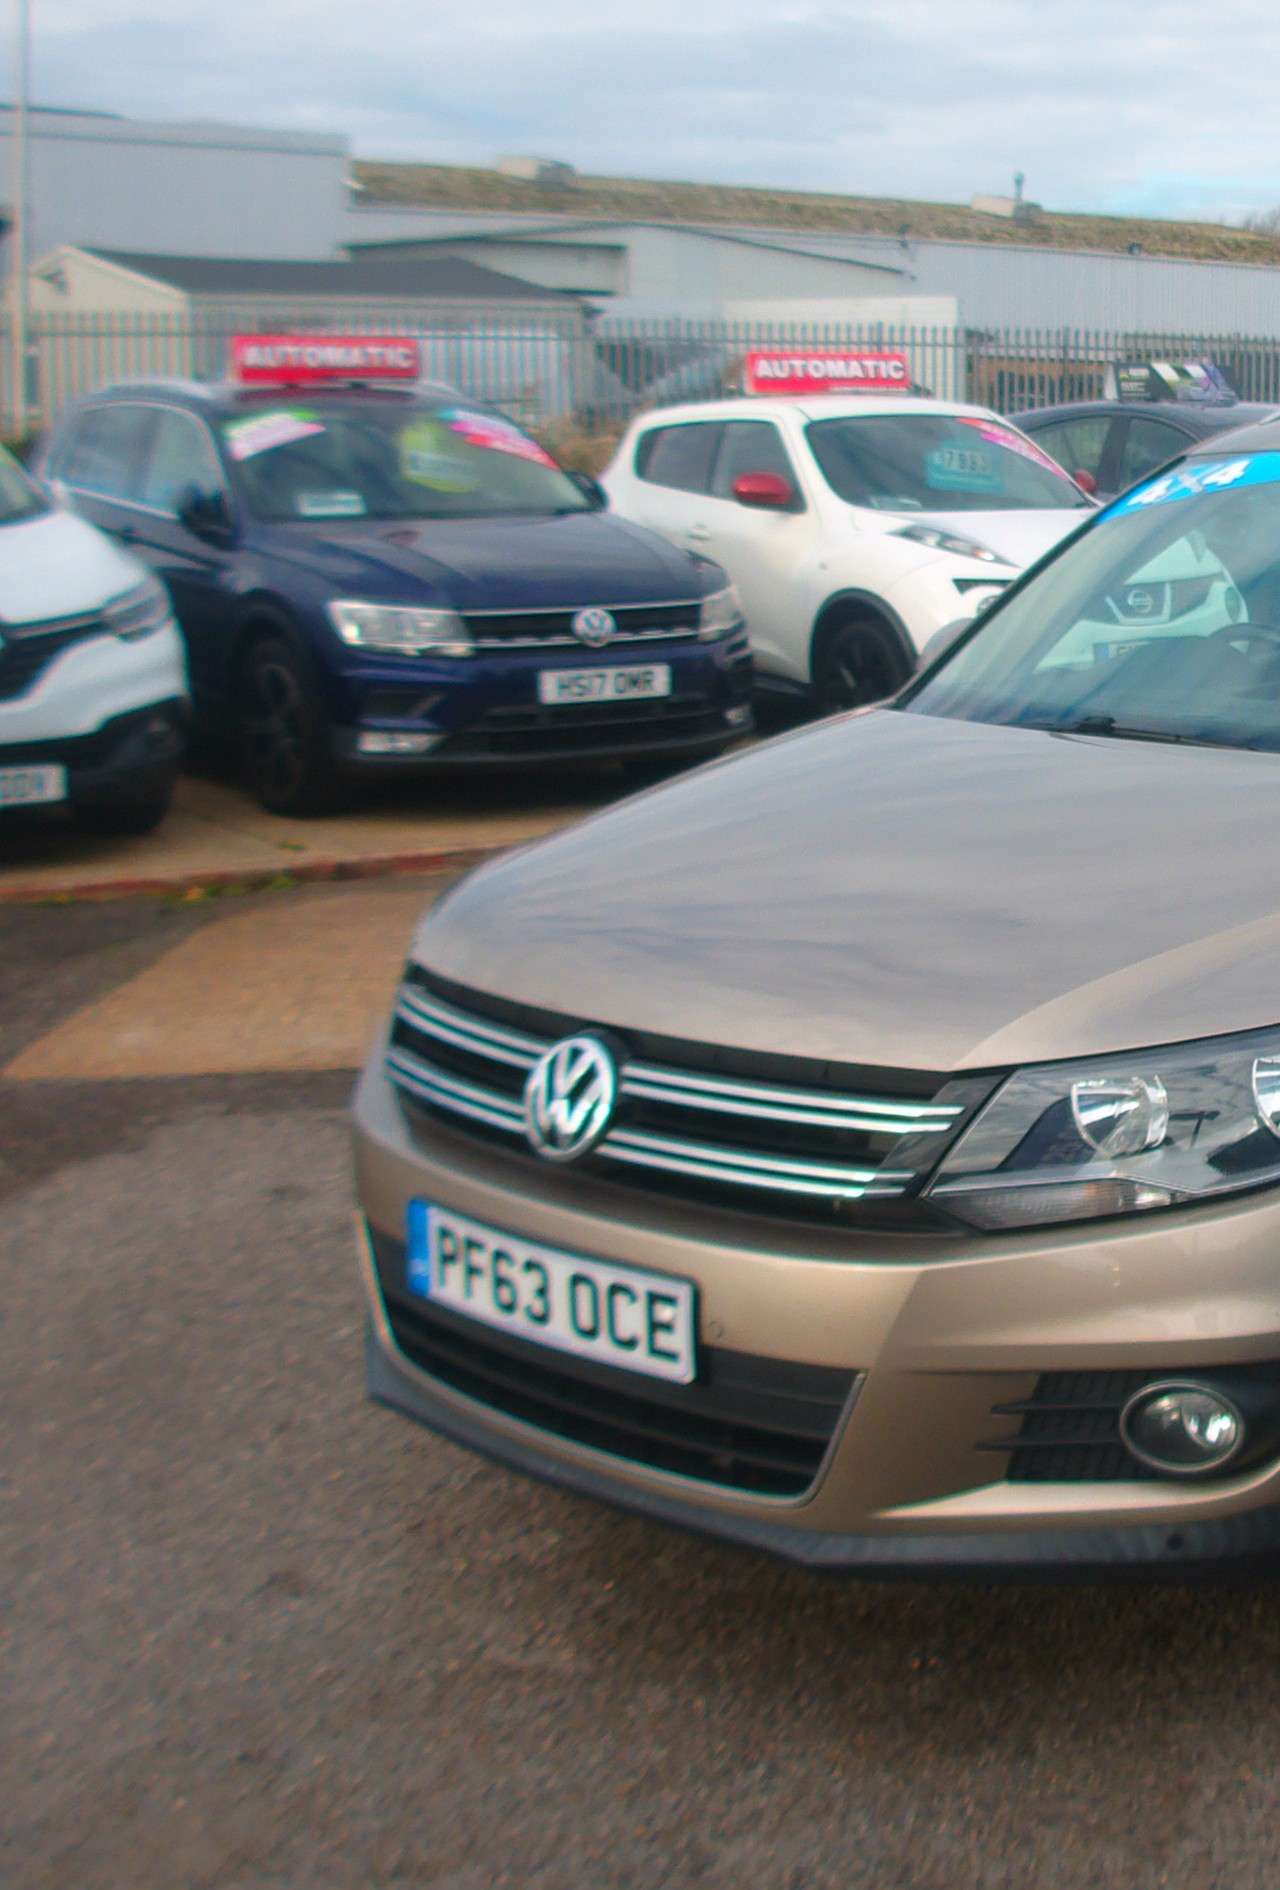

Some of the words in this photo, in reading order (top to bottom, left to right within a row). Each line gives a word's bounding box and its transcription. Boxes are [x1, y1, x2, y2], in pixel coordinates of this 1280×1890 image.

[244, 345, 416, 368] AUTOMATIC
[756, 359, 905, 380] AUTOMATIC
[436, 1224, 551, 1328] PF63
[568, 1272, 681, 1363] OCE
